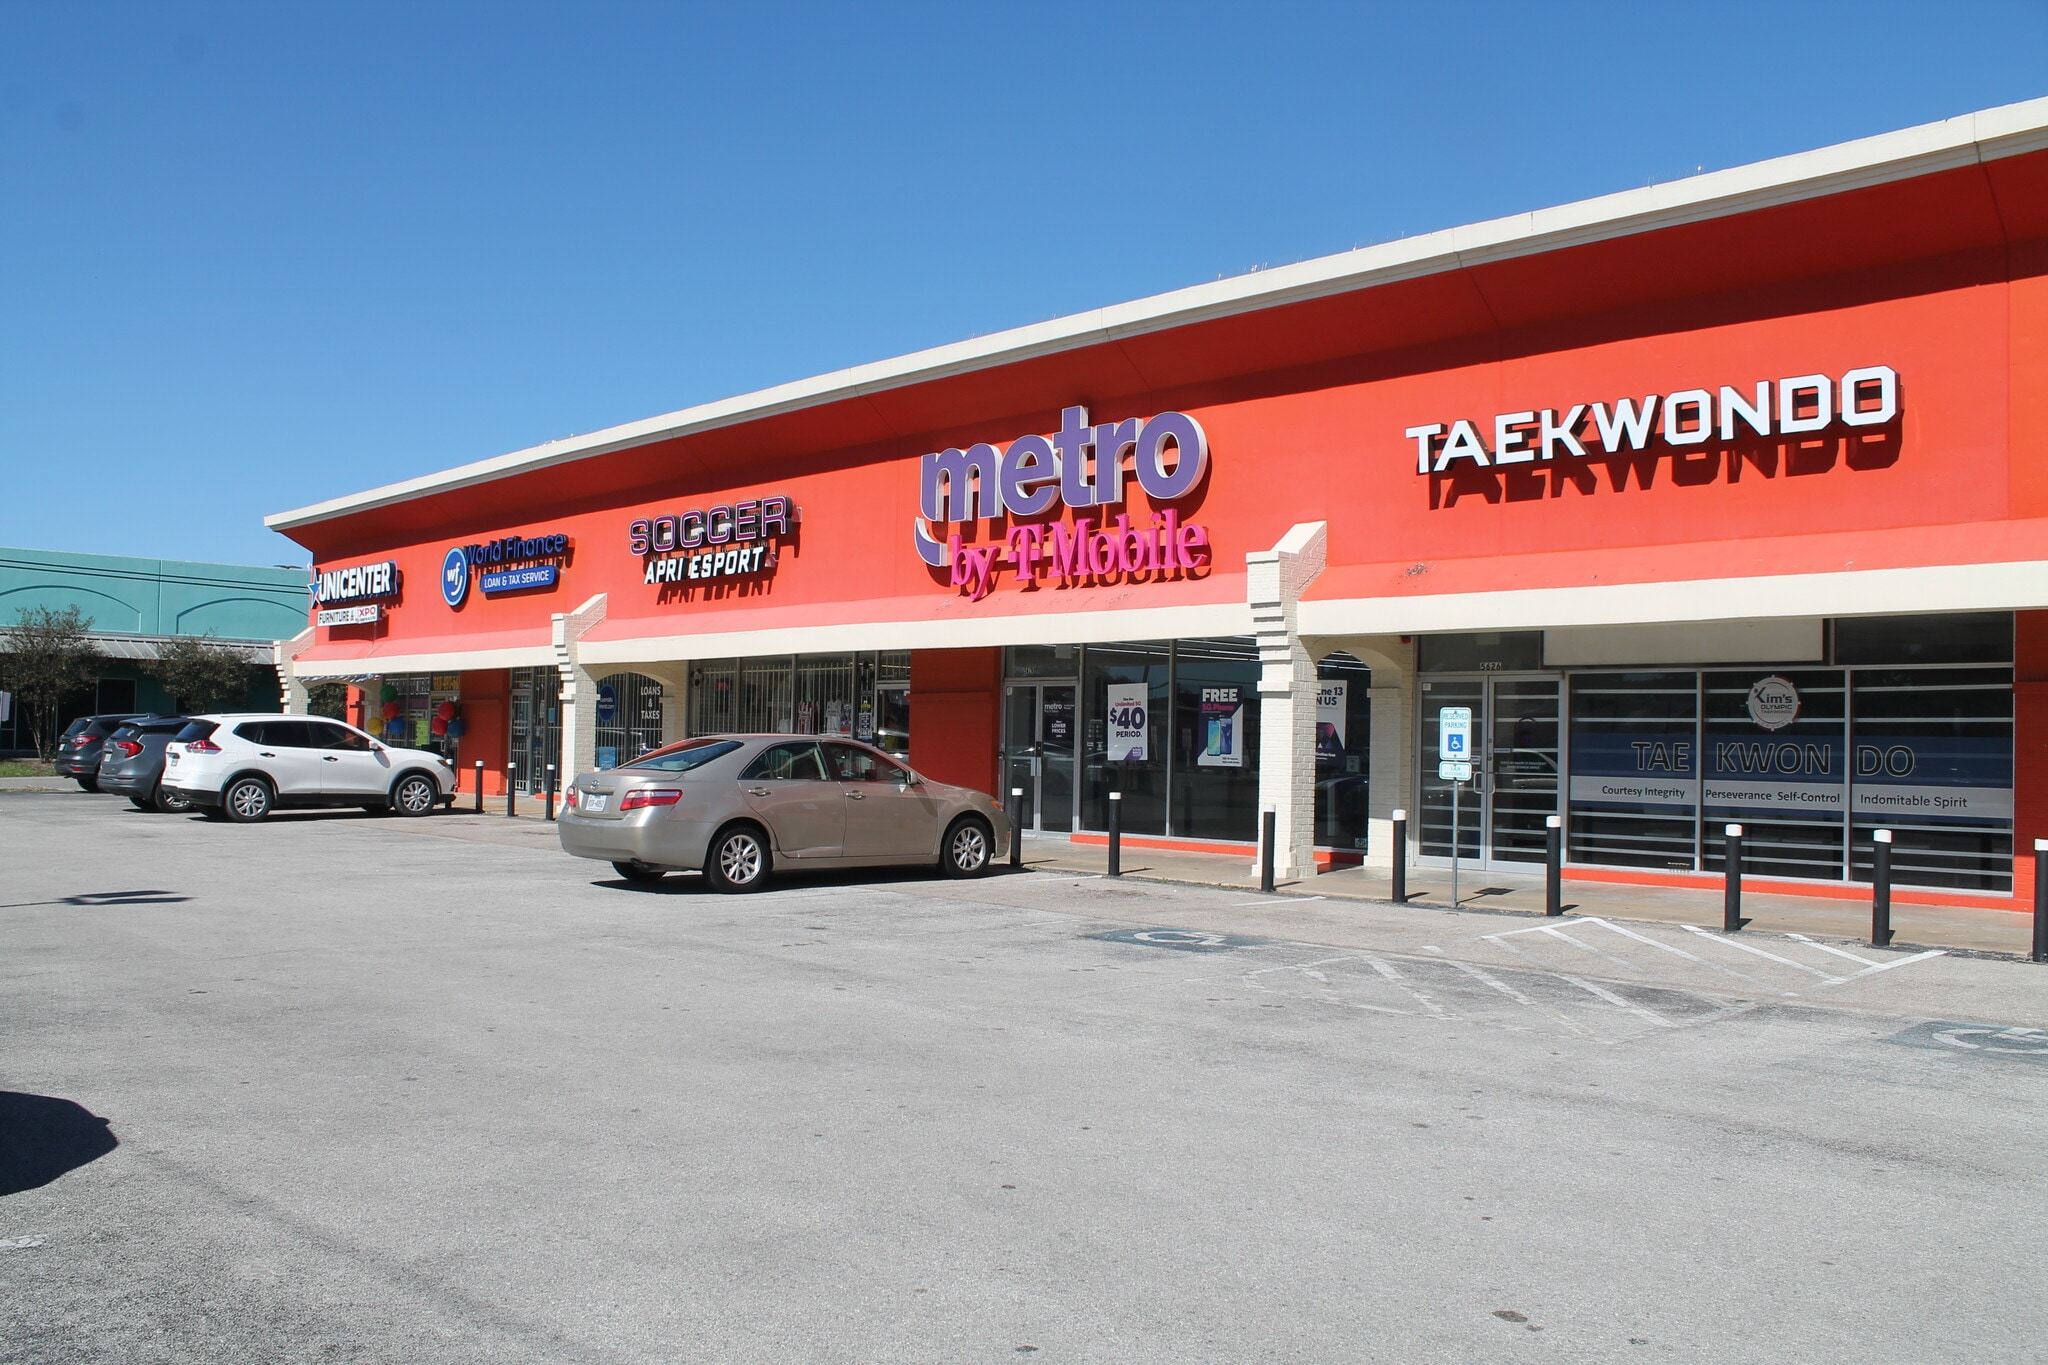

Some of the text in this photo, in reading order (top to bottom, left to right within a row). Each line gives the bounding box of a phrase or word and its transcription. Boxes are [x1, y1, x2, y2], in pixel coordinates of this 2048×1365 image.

[1404, 364, 1898, 475] TAEKWONDO
[919, 404, 1206, 522] metro
[629, 495, 788, 556] SOCCER
[463, 533, 567, 565] World Finance
[643, 556, 685, 585] APRI
[949, 534, 998, 601] by
[318, 561, 392, 602] UNICENTER
[484, 569, 550, 589] LOAN & TAX SERVICE
[318, 610, 350, 625] FURNITURE
[1481, 662, 1501, 671] 5626
[640, 686, 661, 696] LOANS
[1202, 688, 1238, 703] FREE
[1333, 686, 1344, 696] 13
[1753, 686, 1793, 704] Kim's
[647, 698, 653, 708] &
[1324, 696, 1338, 706] US
[641, 710, 660, 720] TAXES
[1110, 707, 1146, 730] $40
[1443, 712, 1469, 720] RESERVED
[1116, 730, 1143, 738] PERIOD.
[1444, 721, 1467, 729] PARKING
[1631, 741, 1915, 778] TAE KWON DO
[1602, 785, 1968, 809] Courtesy Integrity Perseverance Self-Control Indomitable Spirit
